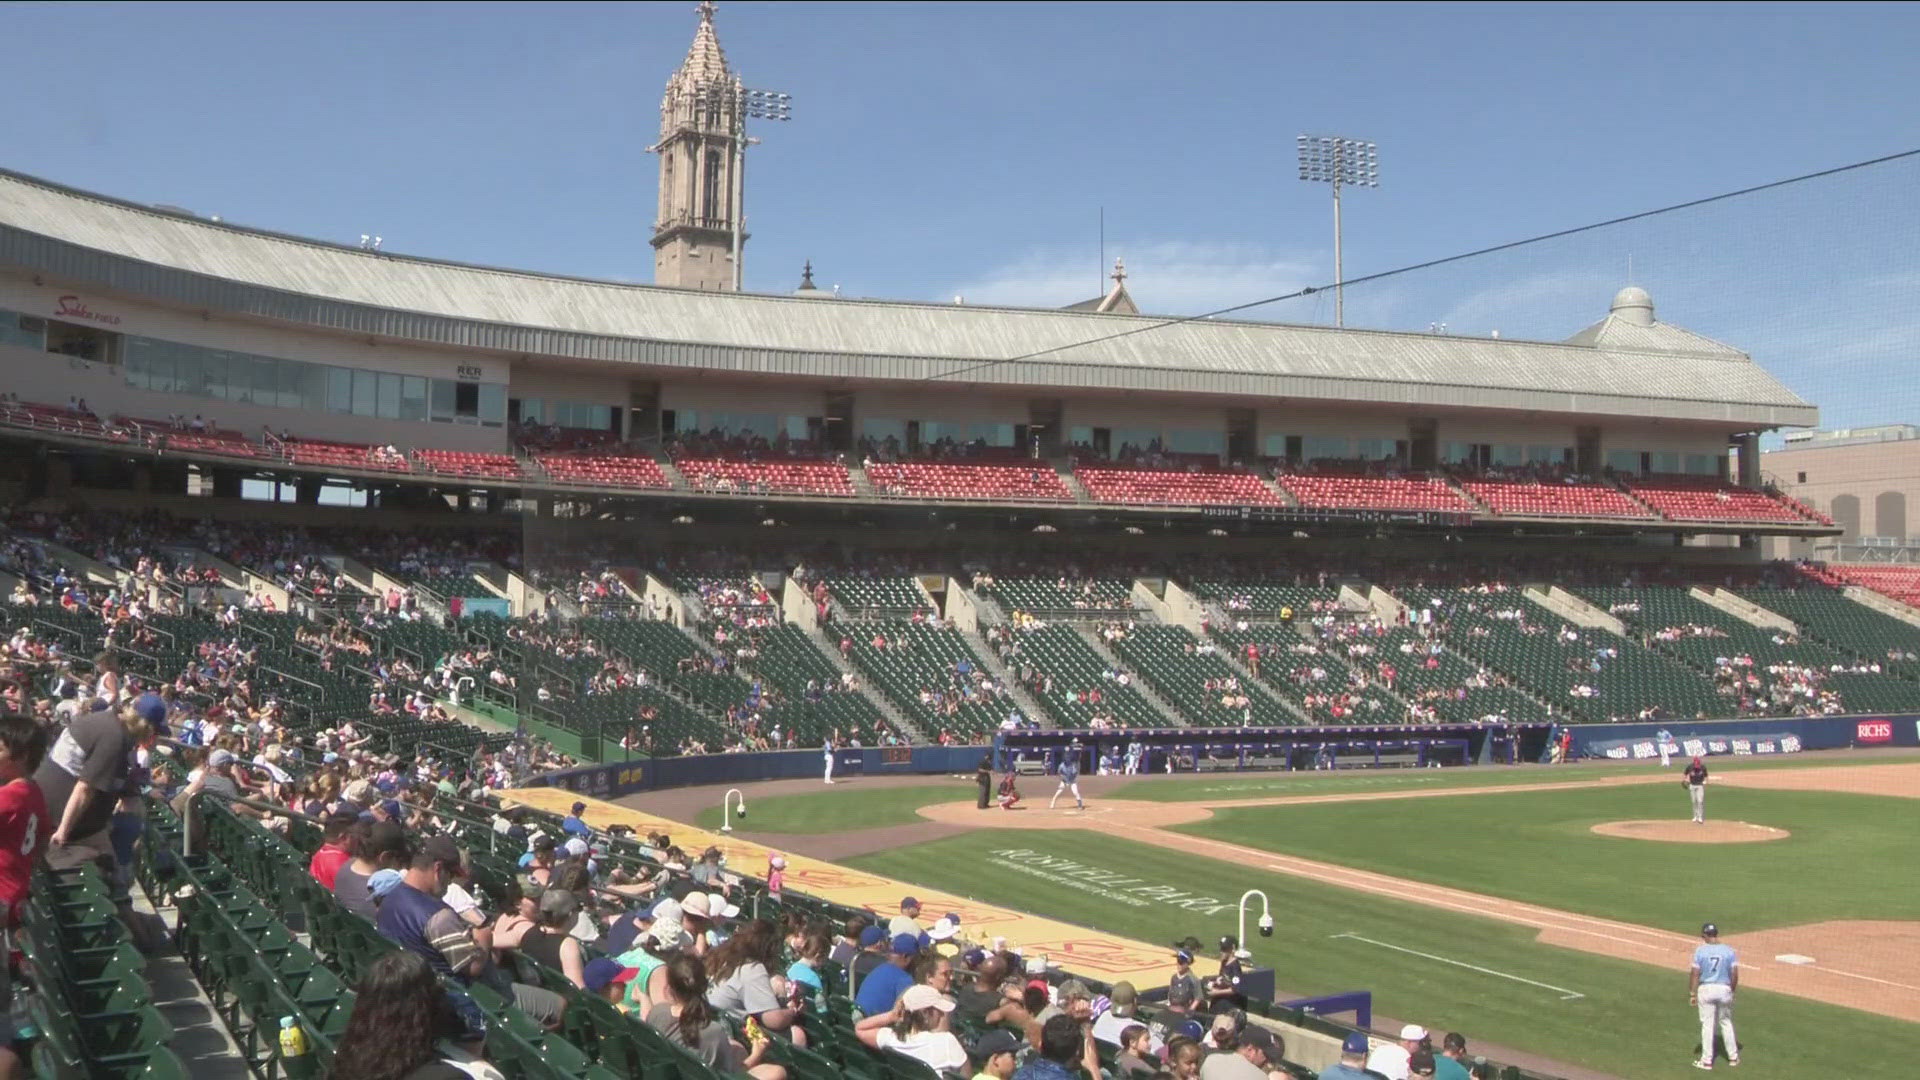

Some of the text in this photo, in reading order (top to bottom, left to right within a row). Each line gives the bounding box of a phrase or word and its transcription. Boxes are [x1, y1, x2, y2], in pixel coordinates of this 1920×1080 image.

[20, 813, 37, 856] 8
[988, 849, 1144, 887] ROSWELL
[1122, 885, 1250, 915] PARK
[1709, 955, 1721, 973] 7
